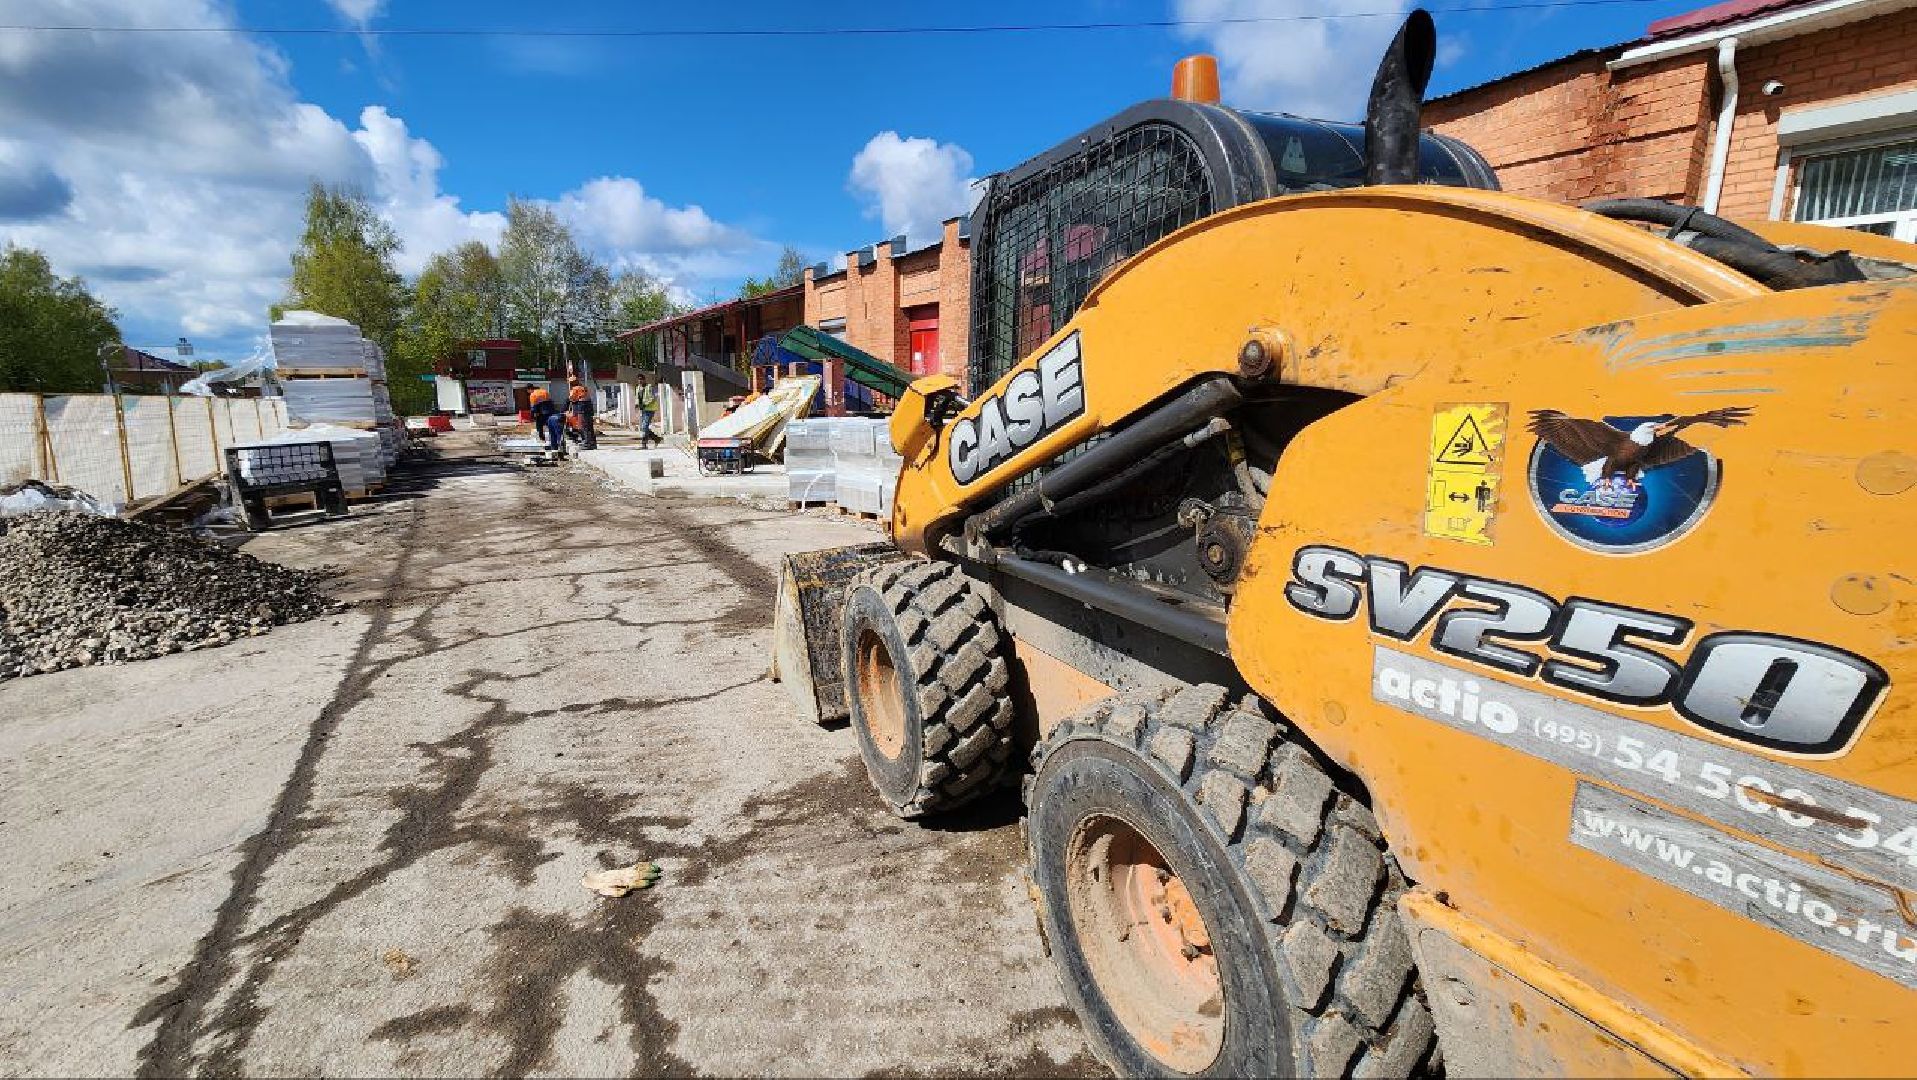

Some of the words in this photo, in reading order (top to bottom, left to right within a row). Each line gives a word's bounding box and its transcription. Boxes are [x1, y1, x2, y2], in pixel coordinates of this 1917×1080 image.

[950, 329, 1085, 486] CASE
[1284, 544, 1889, 755] SV250
[1379, 668, 1518, 734] actio
[1535, 718, 1601, 757] (495)
[1614, 736, 1681, 783] 54
[1583, 809, 1917, 962] www.actio.ru
